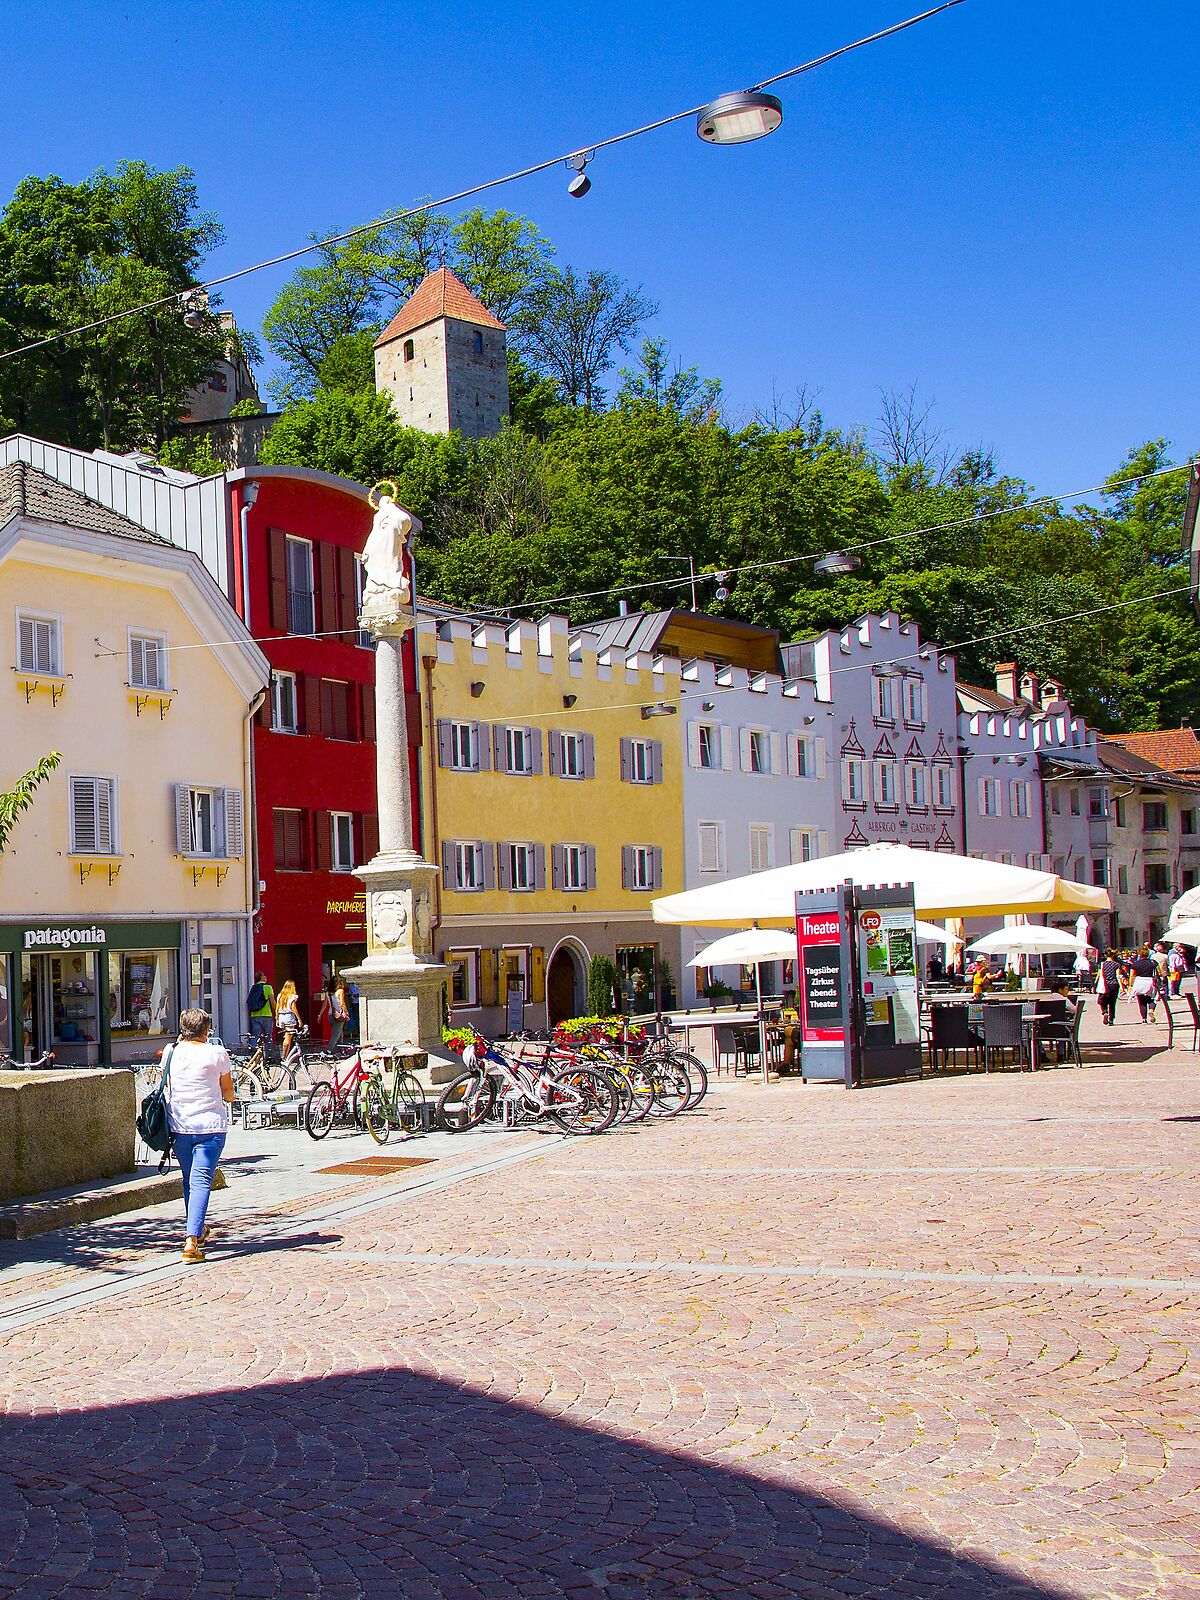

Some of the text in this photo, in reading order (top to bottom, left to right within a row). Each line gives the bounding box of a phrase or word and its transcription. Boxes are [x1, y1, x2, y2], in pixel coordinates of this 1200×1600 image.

[867, 821, 936, 834] ALBERGO GASTHOF
[24, 925, 106, 948] patagonia
[805, 966, 839, 976] Tagsüber
[811, 978, 835, 986] Zirkus
[809, 988, 837, 997] abends
[809, 1000, 839, 1008] Theater
